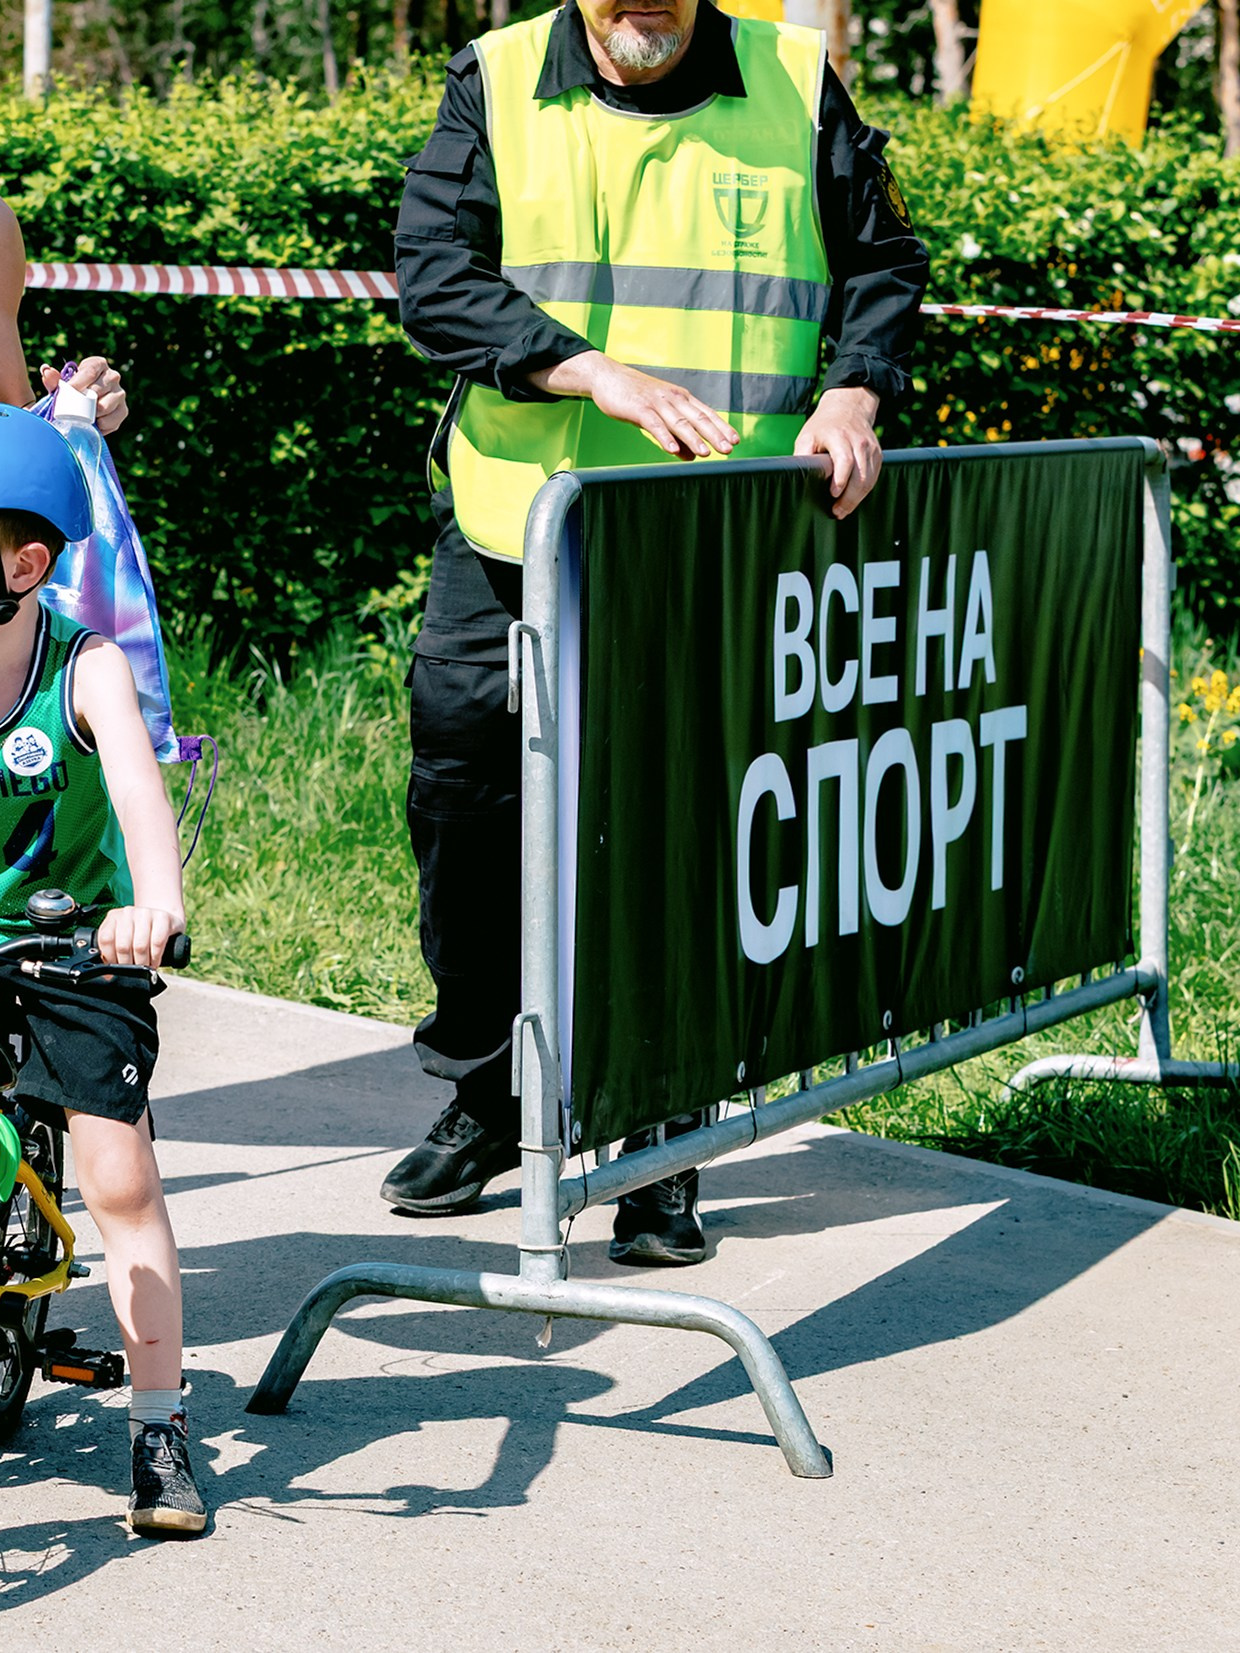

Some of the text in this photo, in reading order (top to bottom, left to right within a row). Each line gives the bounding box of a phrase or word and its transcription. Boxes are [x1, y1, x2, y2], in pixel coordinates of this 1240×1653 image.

[713, 172, 768, 186] ЦЕРБЕР
[774, 550, 996, 723] ВСЕ НА
[737, 705, 1027, 964] СПОРТ
